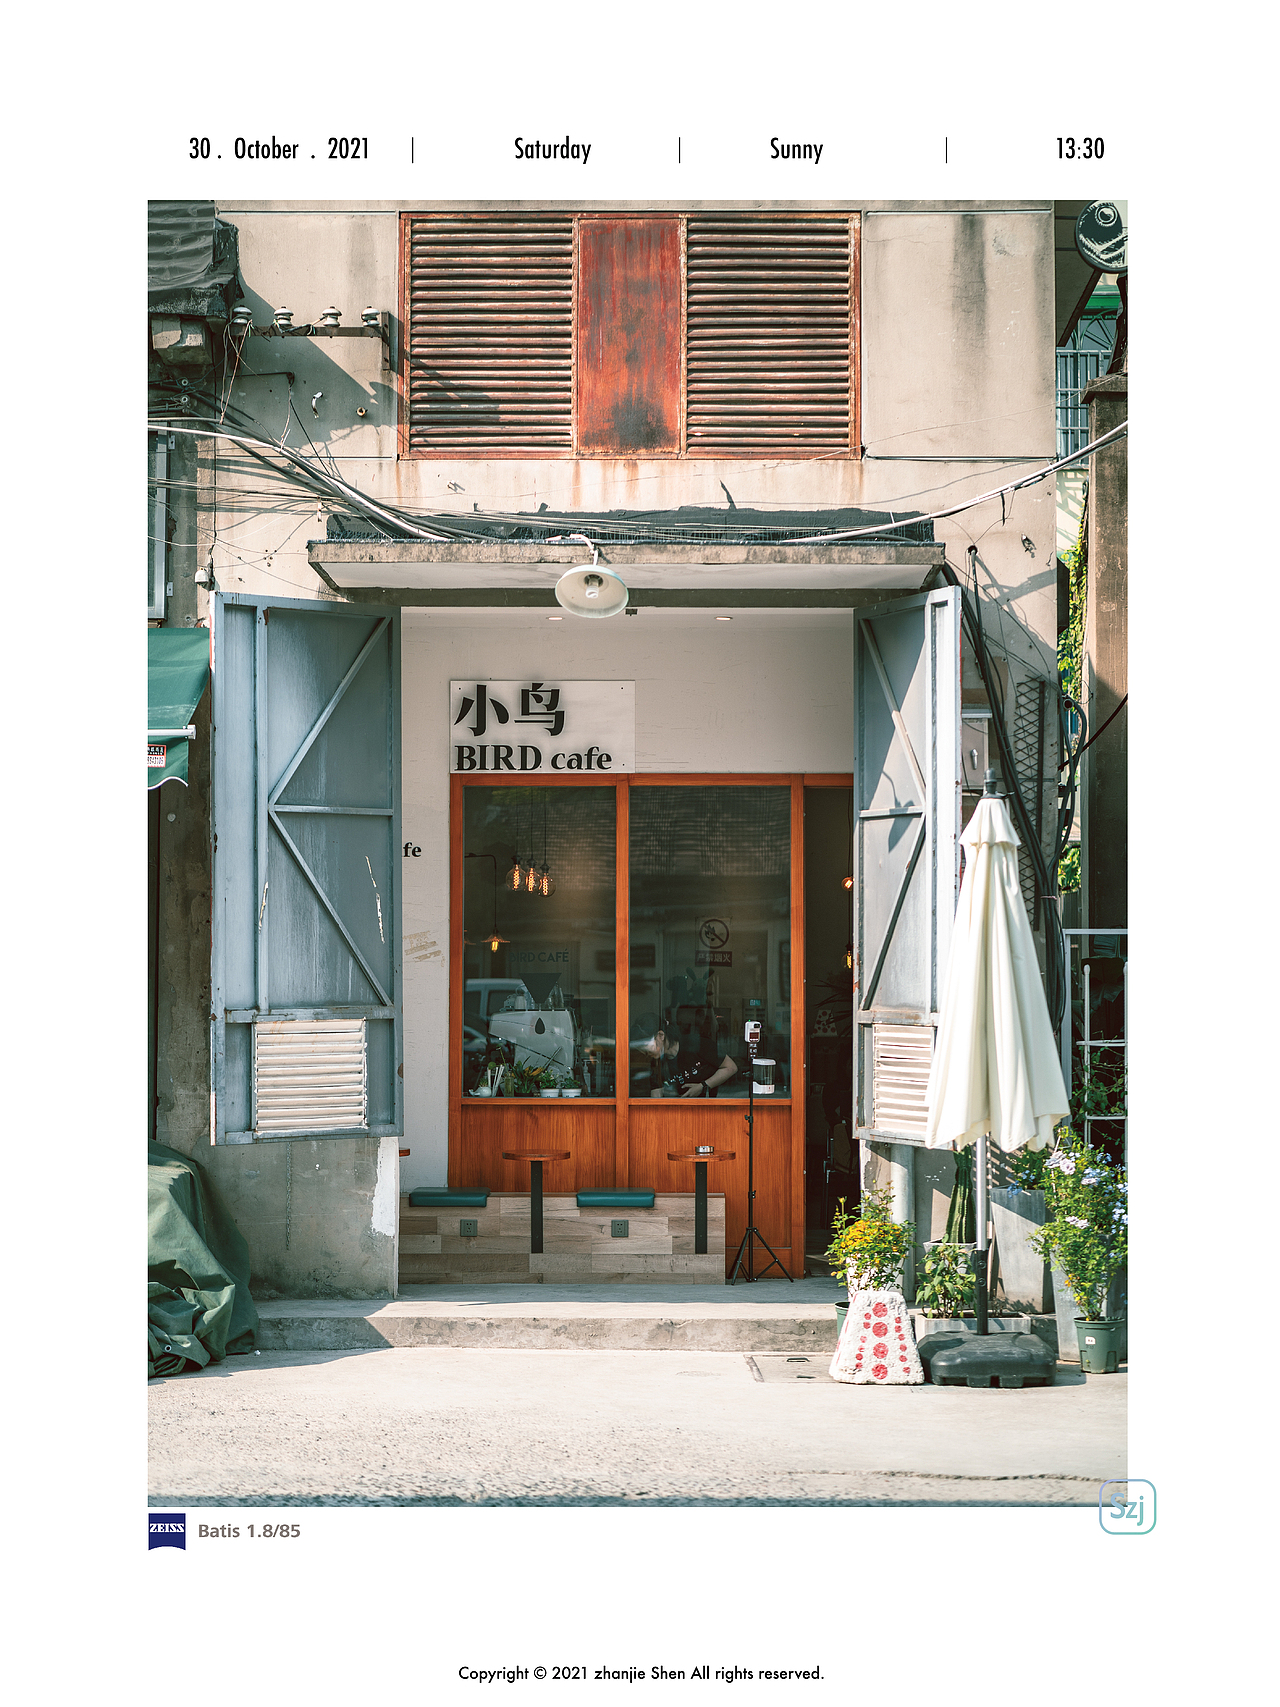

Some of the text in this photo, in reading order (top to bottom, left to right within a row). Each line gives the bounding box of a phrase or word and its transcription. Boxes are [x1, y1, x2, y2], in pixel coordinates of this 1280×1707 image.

[453, 682, 565, 737] 小鸟
[454, 745, 613, 771] BIRD cafe
[508, 948, 569, 963] BIRD CAFÉ
